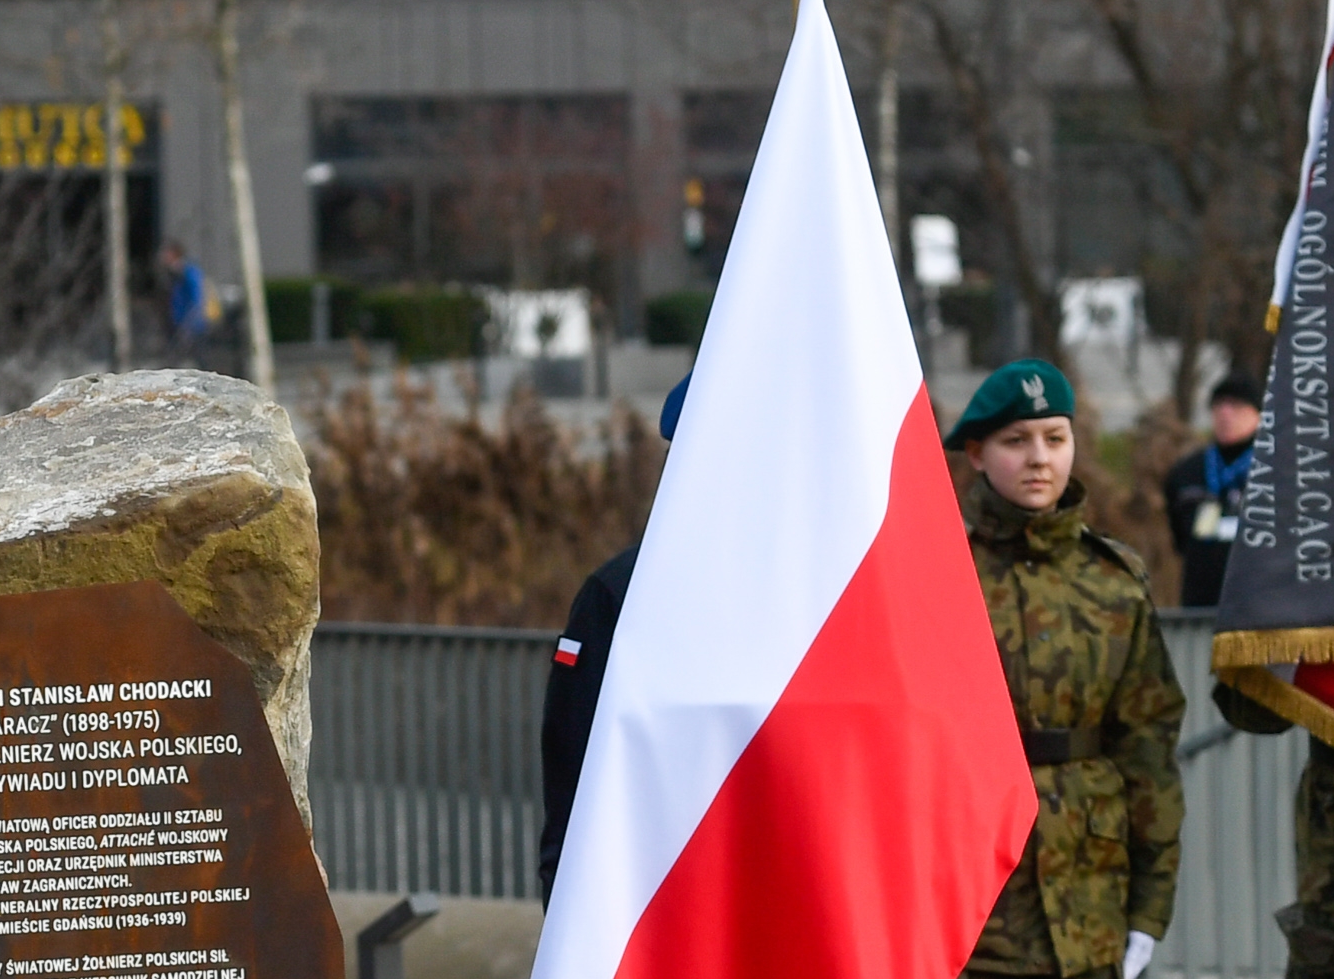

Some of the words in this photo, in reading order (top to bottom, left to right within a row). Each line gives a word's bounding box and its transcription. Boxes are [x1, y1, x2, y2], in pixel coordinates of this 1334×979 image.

[1291, 210, 1334, 582] OGÓLNOKSZTAŁCĄCE
[9, 684, 113, 706] STANISŁAW
[119, 680, 210, 700] CHODACKI
[63, 709, 159, 736] (1898-1975)
[59, 740, 134, 760] WOJSKA
[140, 735, 242, 757] POLSKIEGO,
[72, 771, 76, 788] I
[82, 766, 188, 788] DYPLOMATA
[52, 816, 96, 830] OFICER
[99, 812, 160, 828] ODDZIAŁU
[164, 812, 171, 824] II
[175, 809, 222, 824] SZTABU
[25, 836, 97, 852] POLSKIEGO,
[99, 830, 155, 848] ATTACHÉ
[157, 829, 227, 845] WOJSKOWY
[27, 858, 62, 872] ORAZ
[65, 854, 126, 871] URZĘDNIK
[129, 849, 222, 866] MINISTERSTWA
[23, 875, 132, 893] ZAGRANICZNYCH.
[62, 892, 186, 910] RZECZYPOSPOLITEJ
[190, 888, 249, 903] POLSKIEJ
[0, 918, 49, 934] MIEŚCIE
[53, 915, 112, 931] GDAŃSKU
[116, 912, 186, 929] (1936-1939)
[6, 958, 79, 975] ŚWIATOWEJ
[82, 954, 142, 970] ŻOŁNIERZ
[146, 950, 206, 966] POLSKICH
[210, 949, 229, 963] SIŁ
